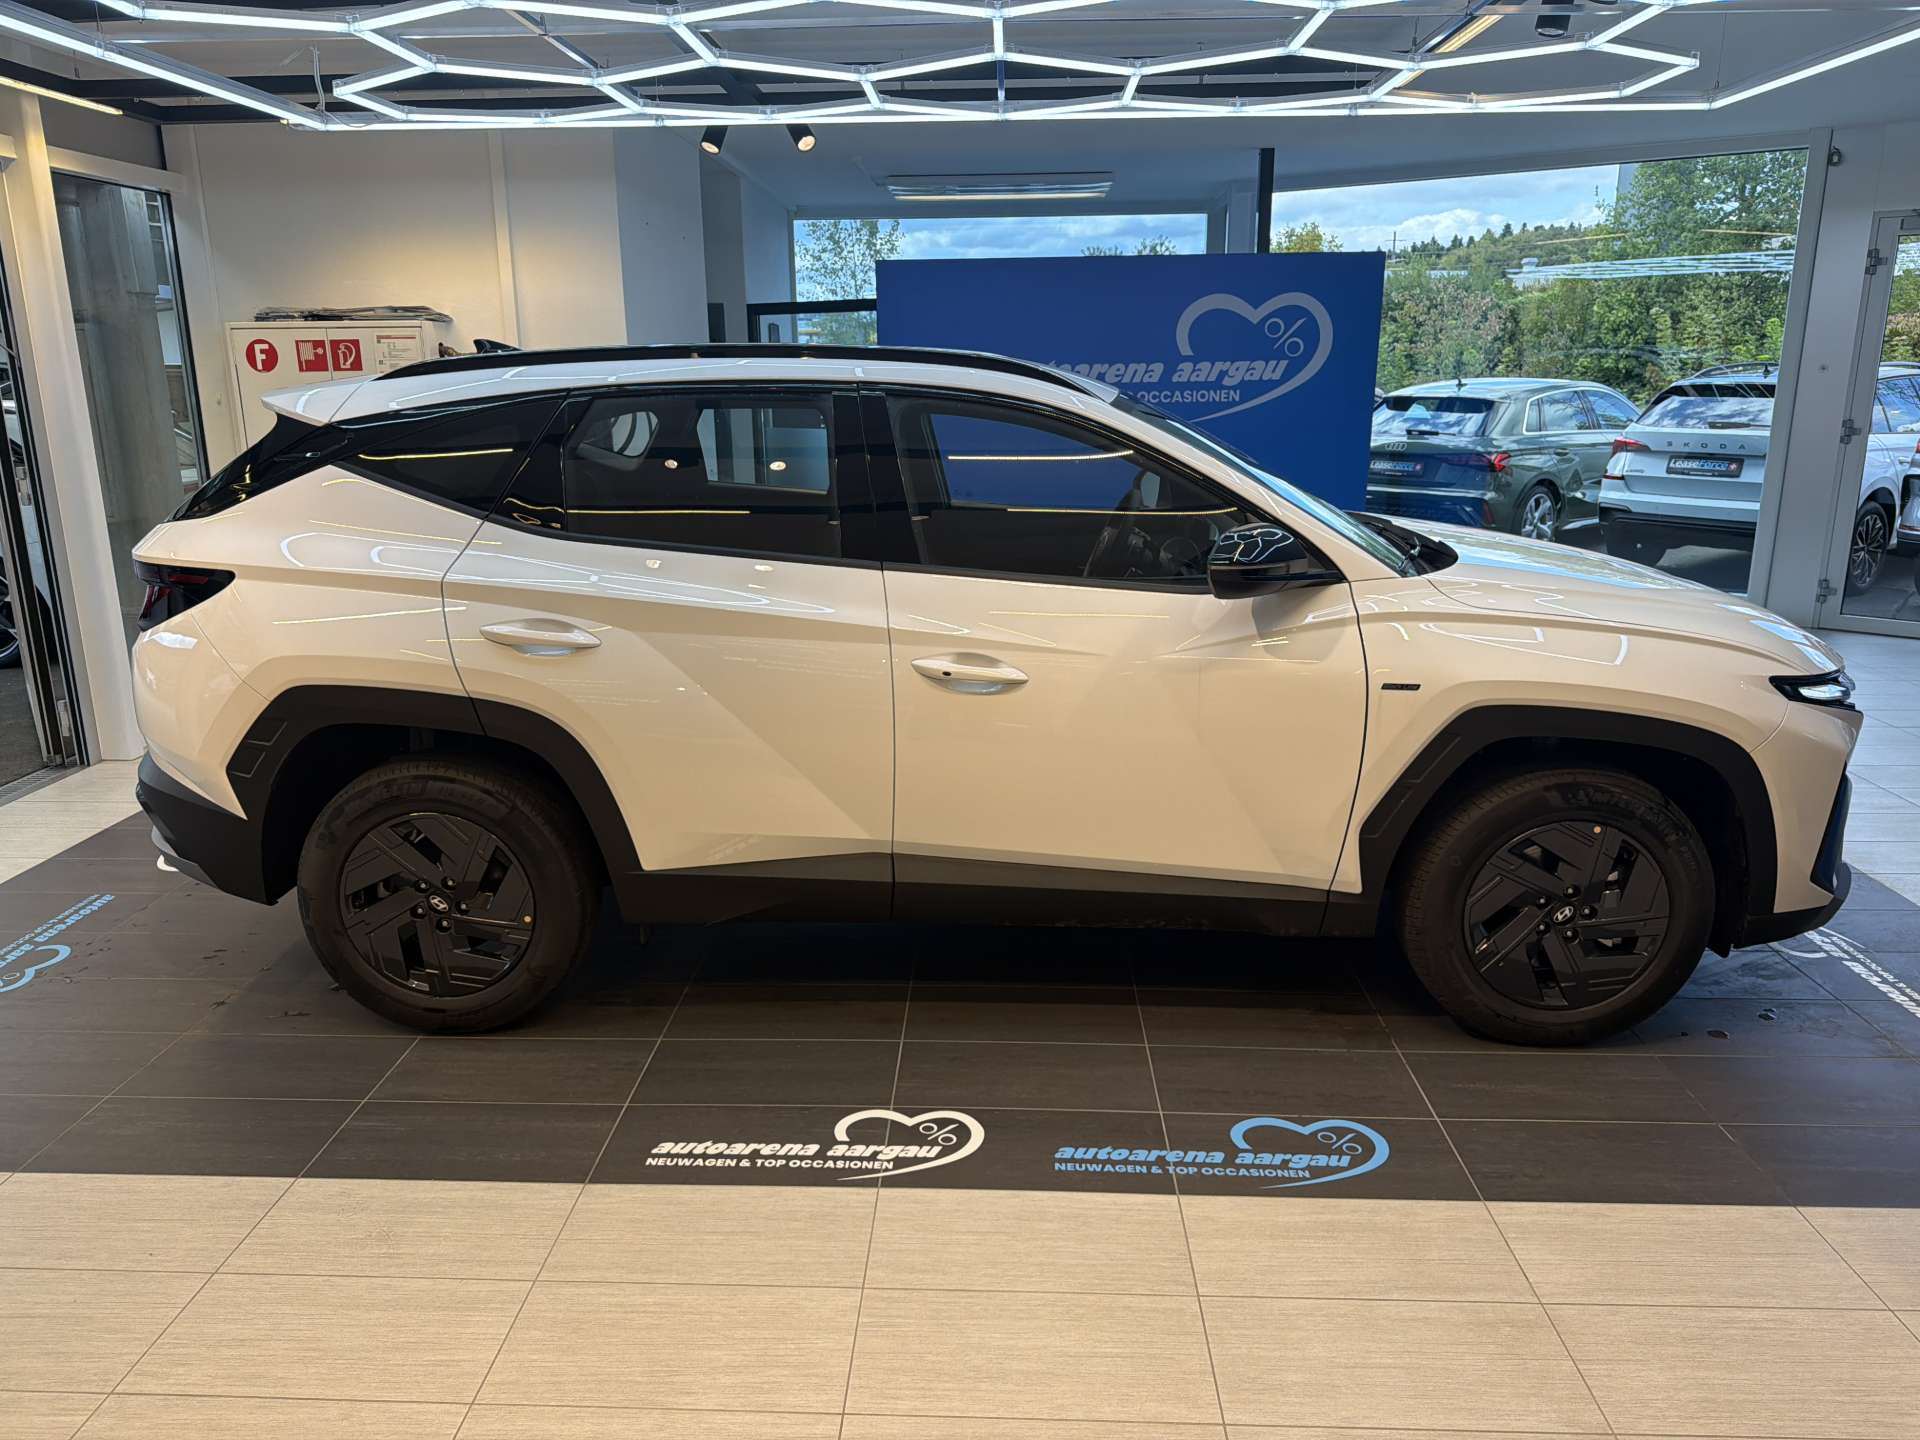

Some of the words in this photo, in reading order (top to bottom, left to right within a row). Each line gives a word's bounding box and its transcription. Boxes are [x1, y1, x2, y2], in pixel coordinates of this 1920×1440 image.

[253, 343, 270, 371] F
[1172, 360, 1288, 386] aargau
[1137, 389, 1240, 403] OCCASIONEN
[651, 1140, 821, 1156] autoarena
[826, 1144, 943, 1160] aargau
[1054, 1145, 1225, 1164] autoarena
[1234, 1152, 1351, 1168] aargau
[645, 1157, 737, 1167] NEUWAGEN
[739, 1158, 752, 1167] &
[754, 1159, 787, 1168] TOP
[788, 1159, 893, 1170] OCCASIONEN
[1054, 1162, 1148, 1174] NEUWAGEN
[1150, 1165, 1163, 1174] &
[1165, 1166, 1198, 1175] TOP
[1201, 1167, 1310, 1178] OCCASIONEN
